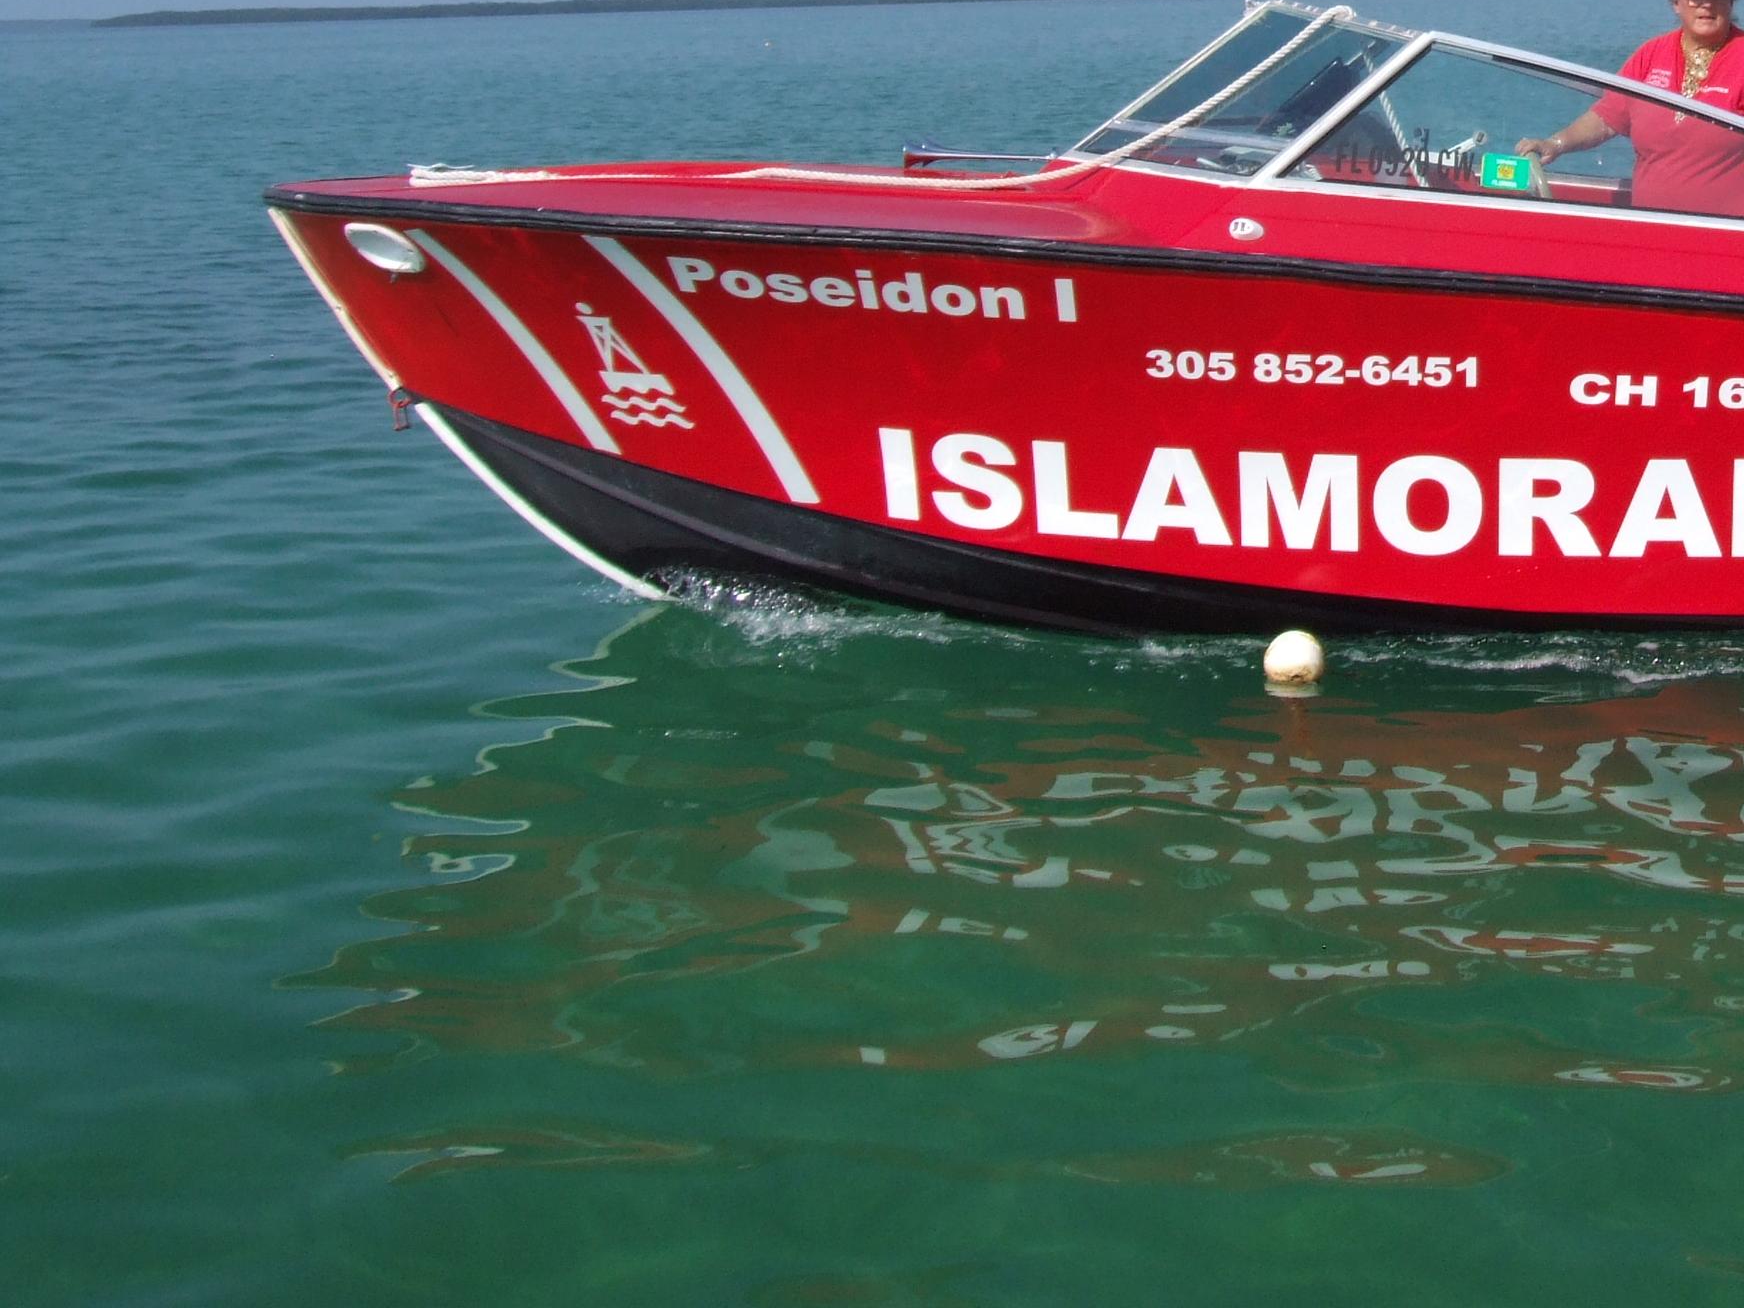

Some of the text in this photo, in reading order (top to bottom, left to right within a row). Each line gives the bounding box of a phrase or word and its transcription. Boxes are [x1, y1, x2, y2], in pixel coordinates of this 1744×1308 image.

[666, 256, 1078, 323] Poseidon I
[1146, 349, 1478, 388] 305 852-6451
[1569, 373, 1658, 407] CH
